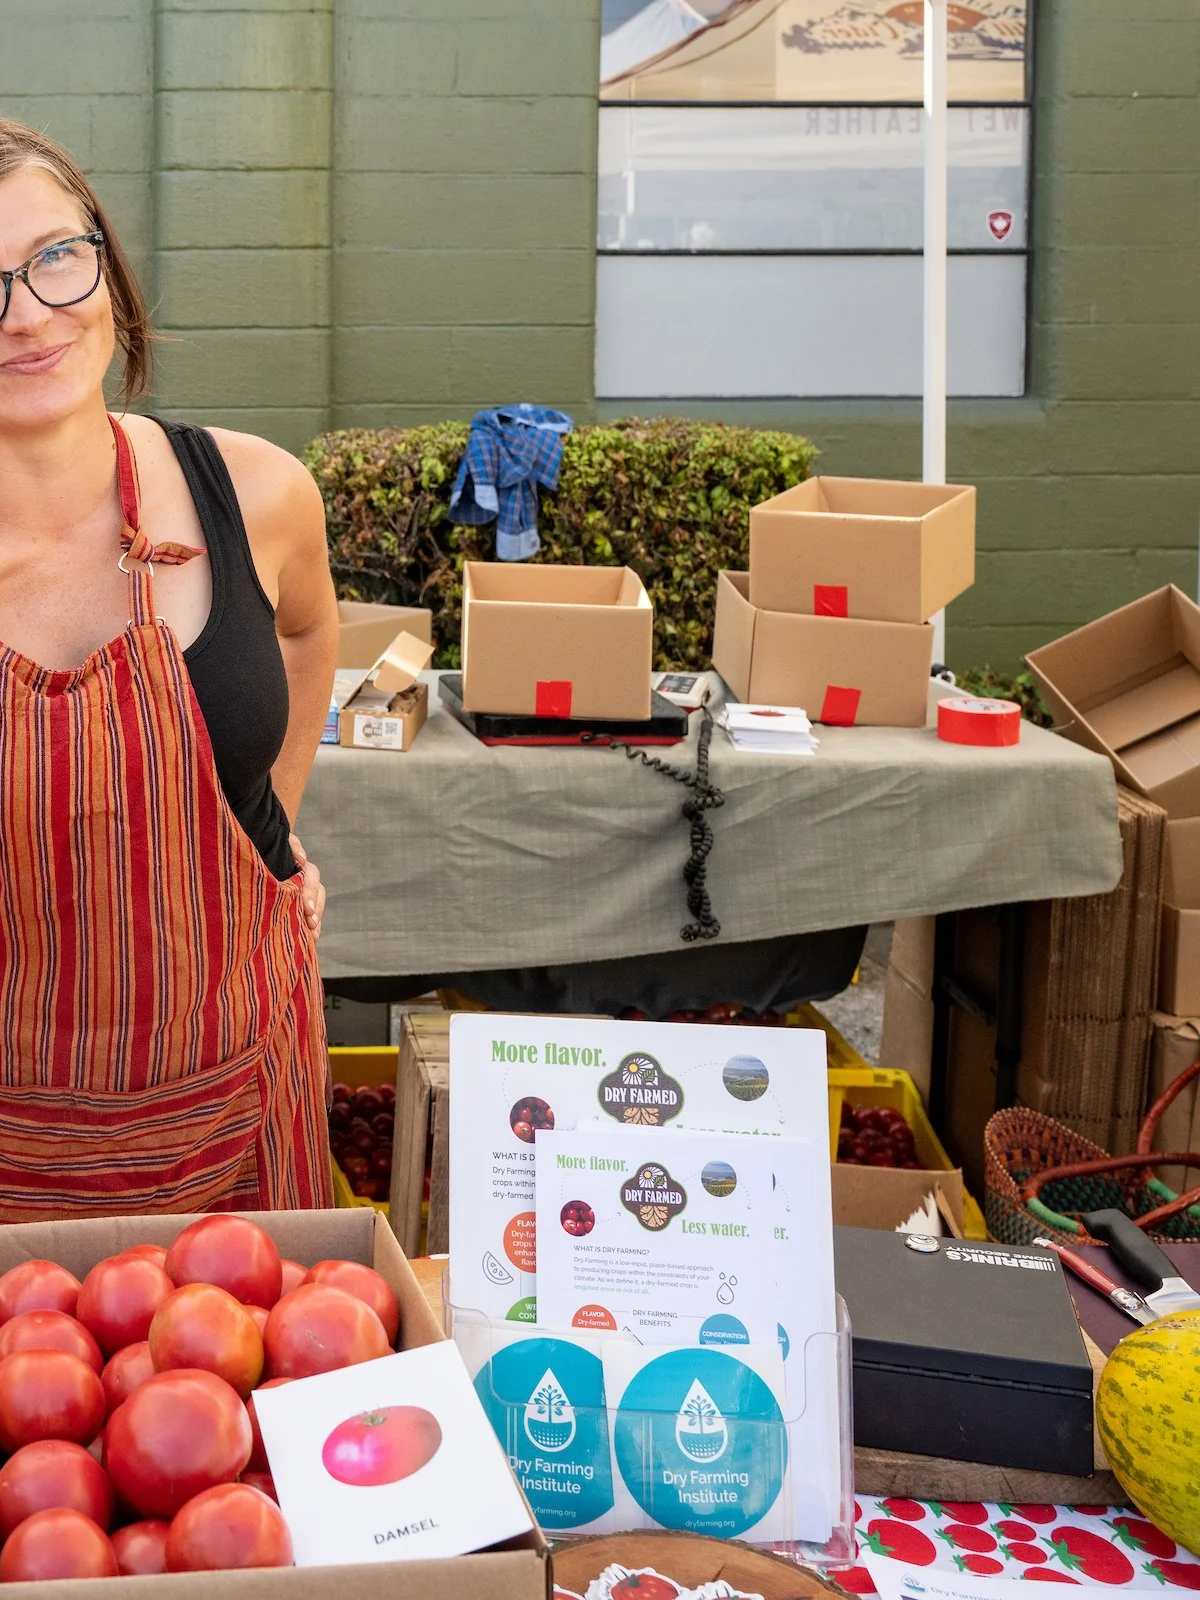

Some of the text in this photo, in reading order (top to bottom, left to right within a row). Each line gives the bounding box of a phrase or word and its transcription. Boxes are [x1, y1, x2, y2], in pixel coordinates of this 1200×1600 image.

[492, 1040, 607, 1067] More flavor.
[604, 1087, 678, 1105] DRY FARMED
[492, 1152, 518, 1160] WHAT
[519, 1153, 528, 1161] IS
[556, 1154, 629, 1172] More flavor.
[492, 1166, 536, 1178] Dry Farming
[492, 1179, 536, 1188] crops within
[492, 1190, 534, 1200] dry-farmed
[625, 1189, 683, 1204] DRY FARMED
[517, 1220, 536, 1228] FLAV
[681, 1219, 750, 1238] Less water.
[511, 1230, 536, 1240] Dry-far
[512, 1241, 532, 1249] crops
[514, 1249, 536, 1257] enhan
[602, 1246, 616, 1254] DRY
[616, 1247, 650, 1256] FARMING?
[945, 1246, 1054, 1263] HOME SECURITY
[573, 1256, 584, 1264] Dry
[584, 1257, 608, 1267] Farming
[945, 1250, 1050, 1271] BRINKS
[582, 1310, 605, 1318] FLAVOR
[632, 1309, 678, 1319] DRY FARMING
[577, 1318, 610, 1328] Dry-farmed
[639, 1319, 672, 1328] BENEFITS
[702, 1330, 746, 1339] CONSERVATION
[508, 1456, 594, 1480] Dry Farming
[663, 1469, 749, 1488] Dry Farming
[522, 1475, 581, 1494] Institute
[678, 1489, 738, 1503] Institute
[685, 1520, 736, 1528] dryfarming.org
[373, 1518, 440, 1545] DAMSEL
